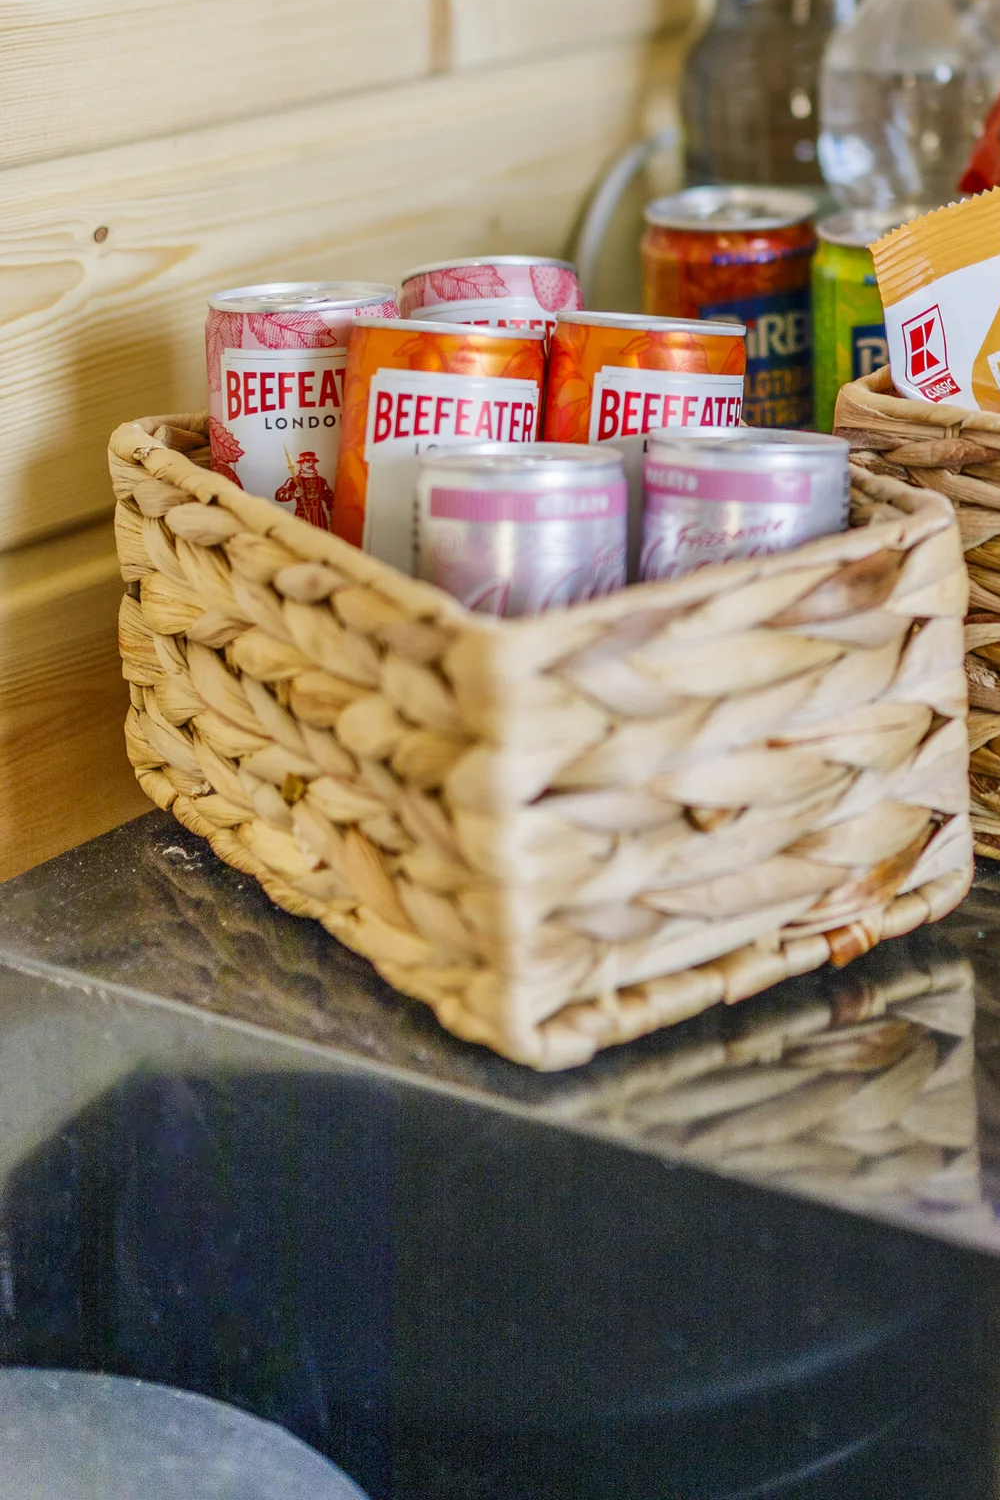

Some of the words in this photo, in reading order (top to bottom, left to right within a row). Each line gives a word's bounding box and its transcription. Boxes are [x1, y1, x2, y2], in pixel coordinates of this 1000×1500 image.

[925, 377, 957, 399] CLASSIC
[265, 414, 342, 430] LONDO
[373, 391, 536, 444] BEEFEATER
